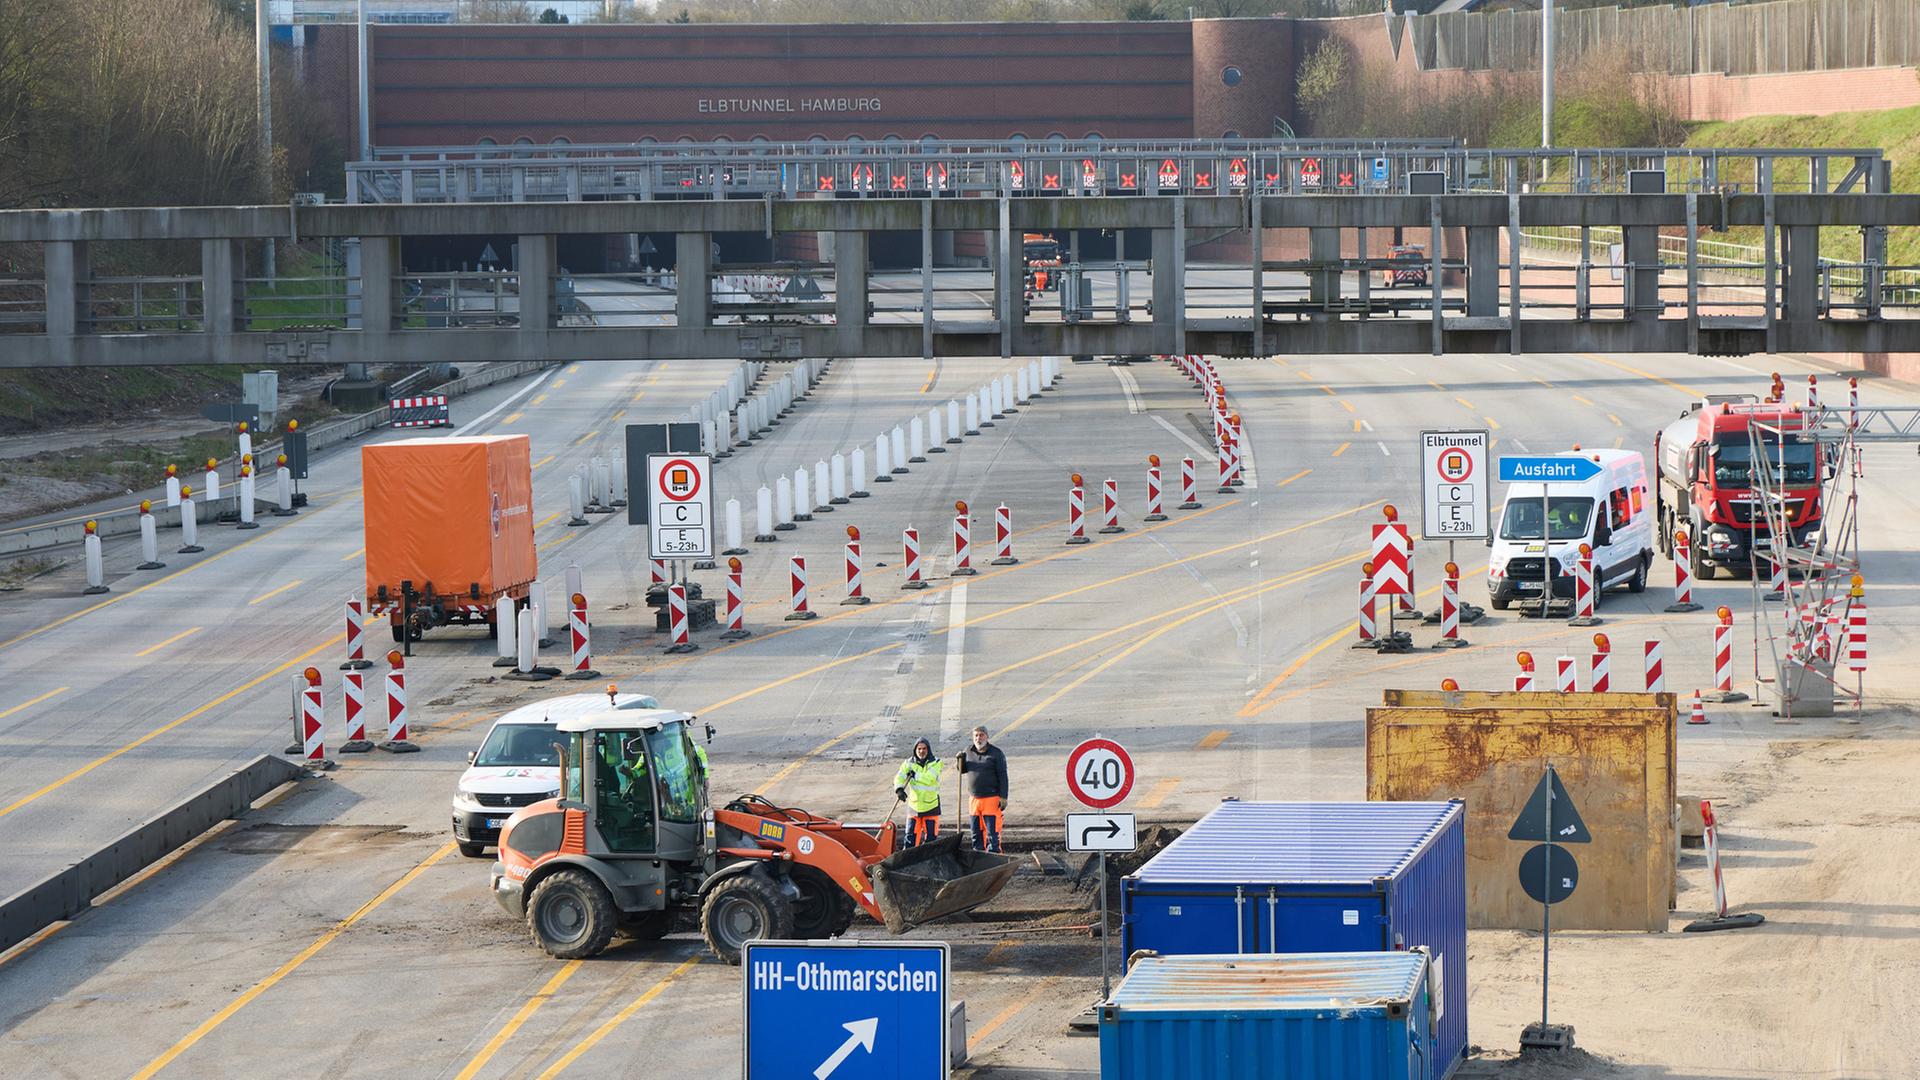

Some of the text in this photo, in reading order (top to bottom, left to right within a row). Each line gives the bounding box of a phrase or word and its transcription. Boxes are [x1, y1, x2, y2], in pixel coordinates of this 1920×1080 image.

[698, 98, 881, 112] ELBTUNNEL HAMBURG
[1159, 174, 1179, 182] STOP
[1301, 174, 1321, 182] STOP
[1427, 435, 1483, 447] Elbtunnel
[1514, 462, 1577, 476] Ausfahrt
[1450, 486, 1461, 501] C
[676, 505, 688, 521] C
[1451, 506, 1461, 520] E
[1441, 521, 1472, 531] 5-23h
[679, 529, 687, 541] E
[666, 541, 698, 551] 5-23h
[1081, 758, 1120, 789] 40
[800, 839, 811, 851] 20
[754, 961, 937, 992] HH-Othmarschen
